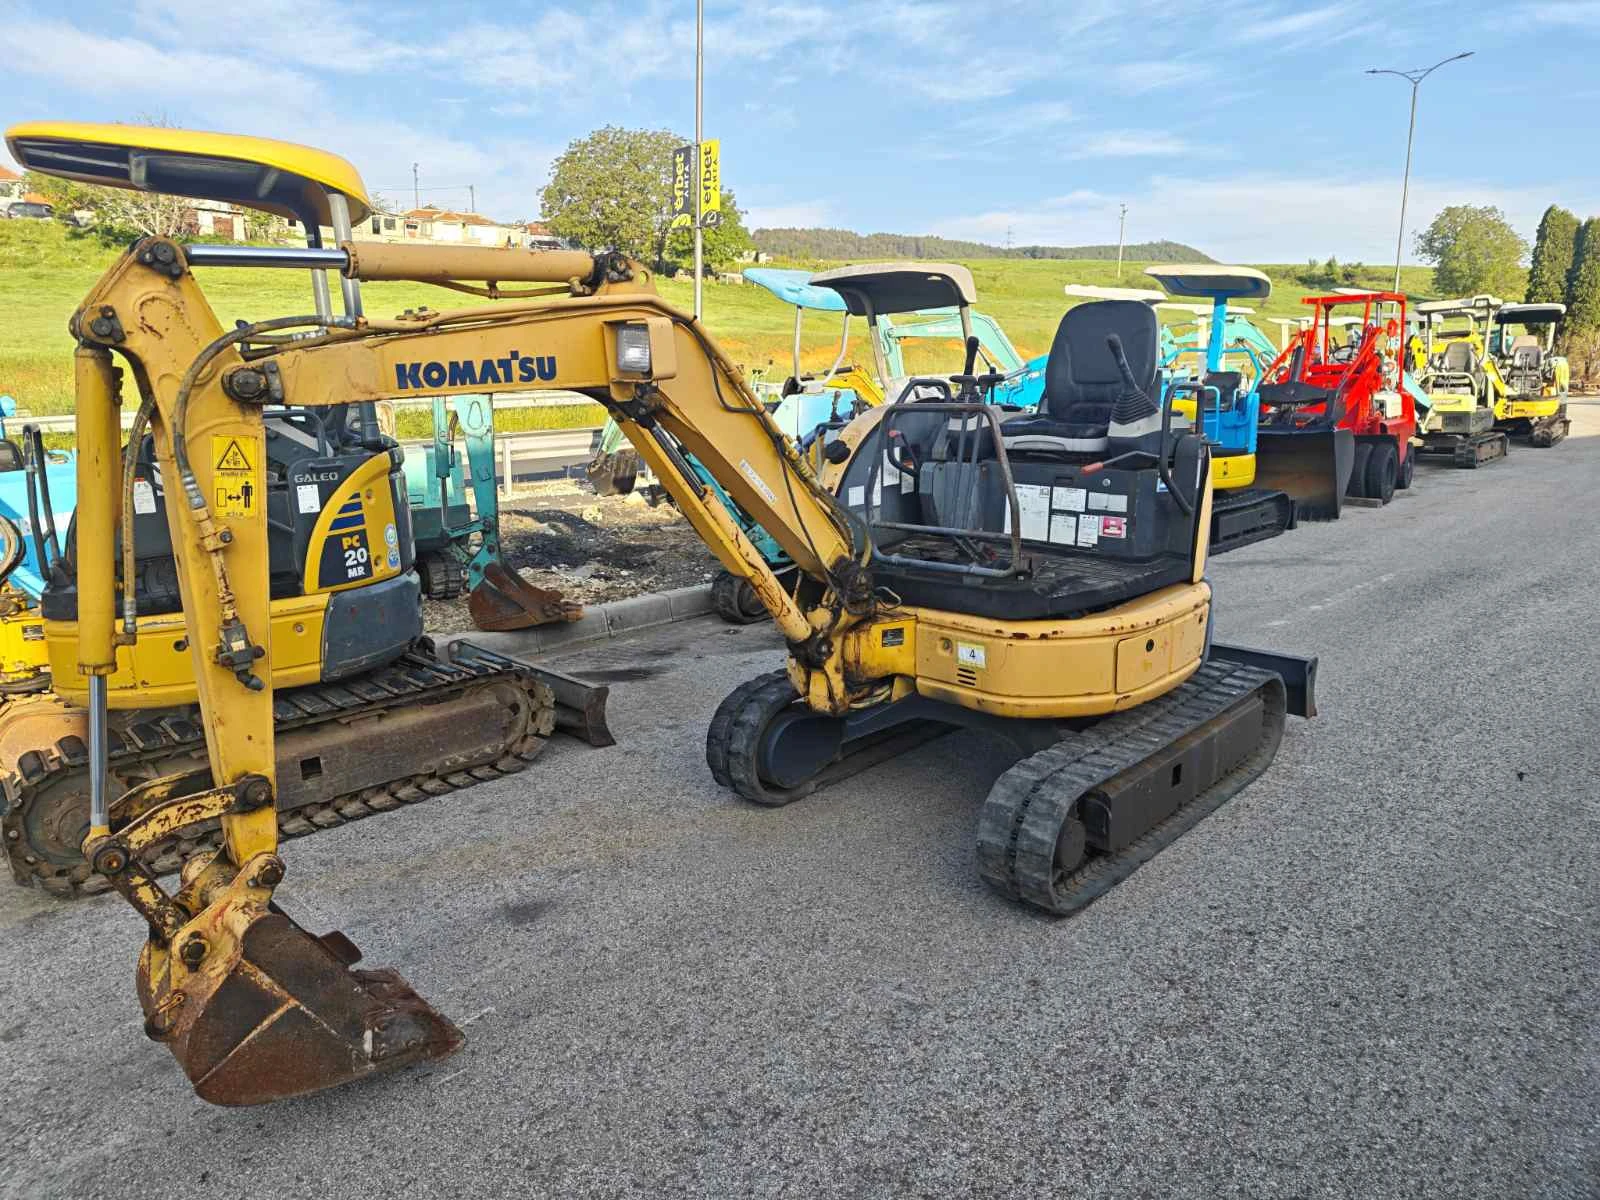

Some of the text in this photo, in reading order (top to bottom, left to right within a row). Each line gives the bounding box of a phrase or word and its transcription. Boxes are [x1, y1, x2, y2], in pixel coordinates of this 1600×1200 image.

[395, 350, 557, 390] KOMATSU
[294, 471, 339, 483] GALEO
[341, 534, 360, 550] PC
[344, 547, 368, 567] 20
[347, 566, 366, 578] MR
